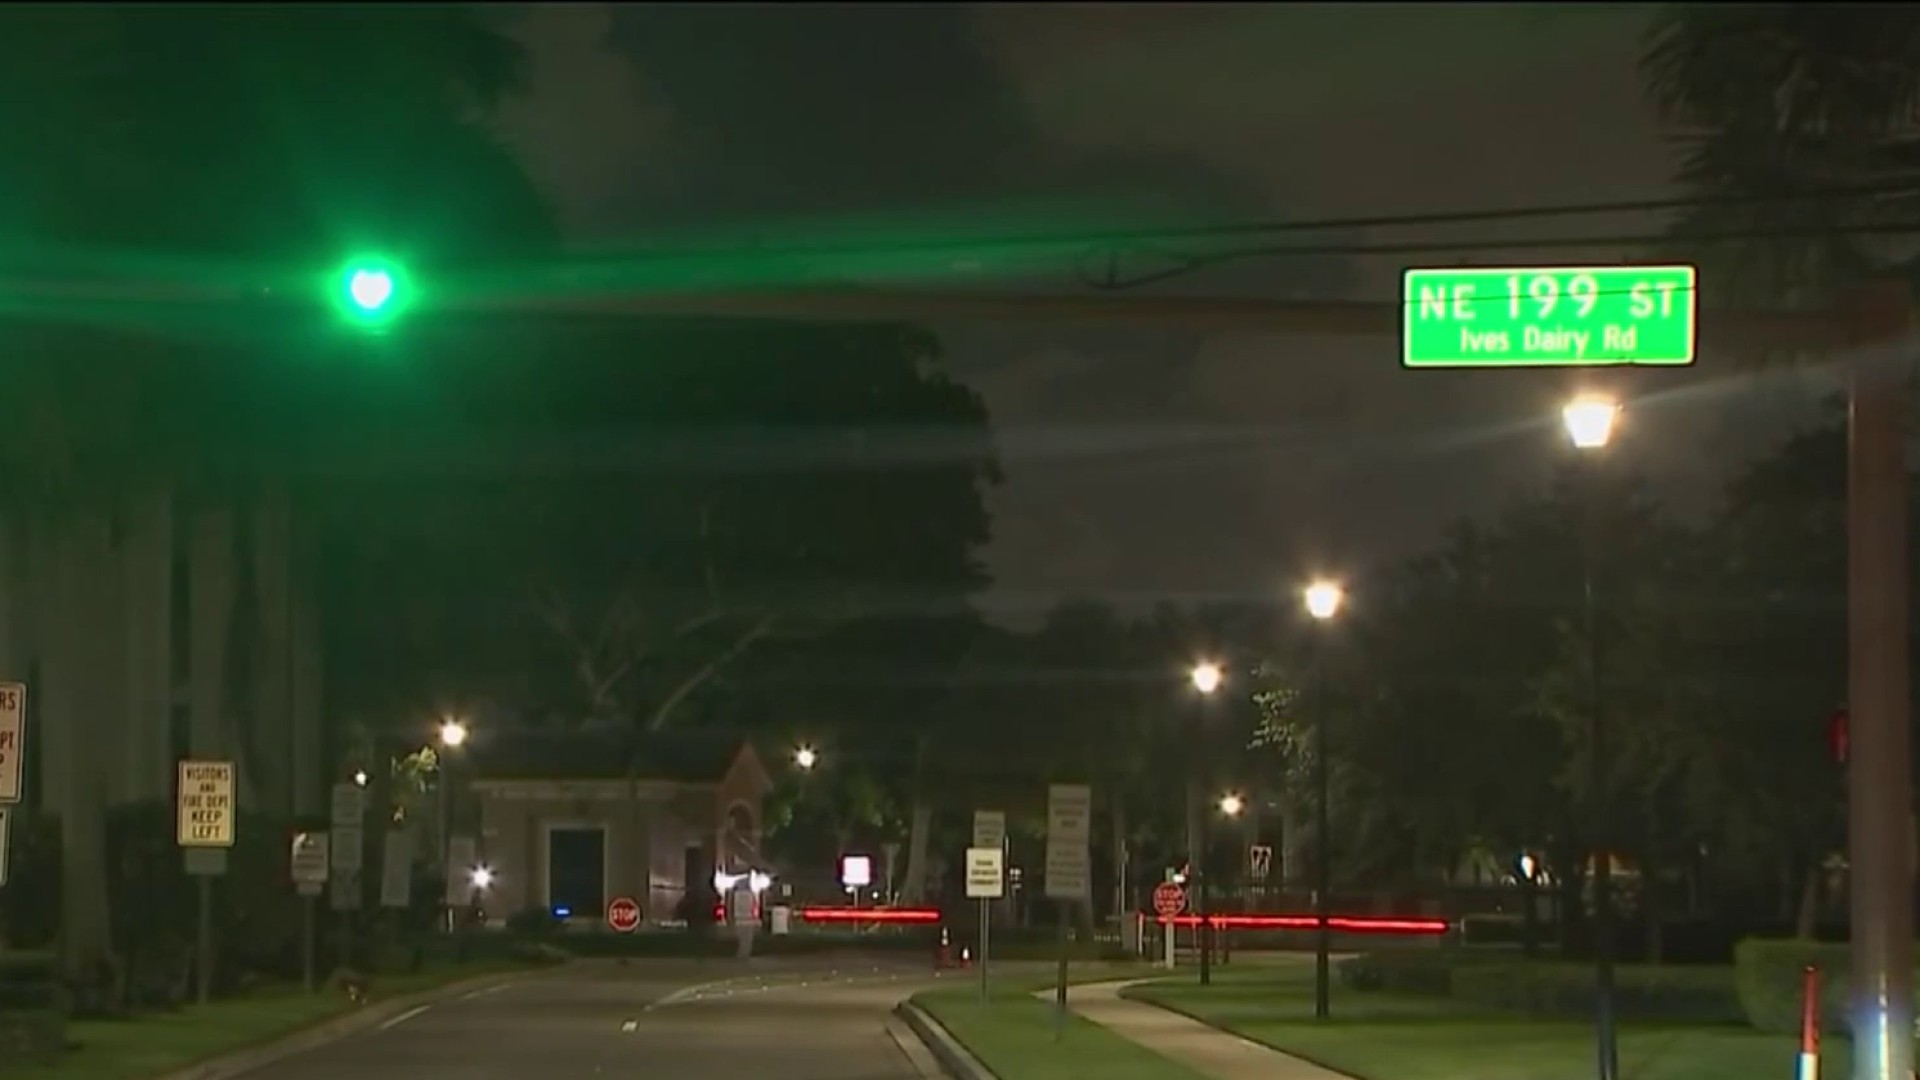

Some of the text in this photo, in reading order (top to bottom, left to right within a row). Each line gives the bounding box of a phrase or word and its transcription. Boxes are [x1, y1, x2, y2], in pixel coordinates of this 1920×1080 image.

[1419, 274, 1681, 320] NE 199 ST
[1460, 323, 1637, 358] Ives Dairy Rd
[192, 811, 222, 823] KEEP
[193, 825, 220, 838] LEFT
[612, 908, 637, 921] STOP
